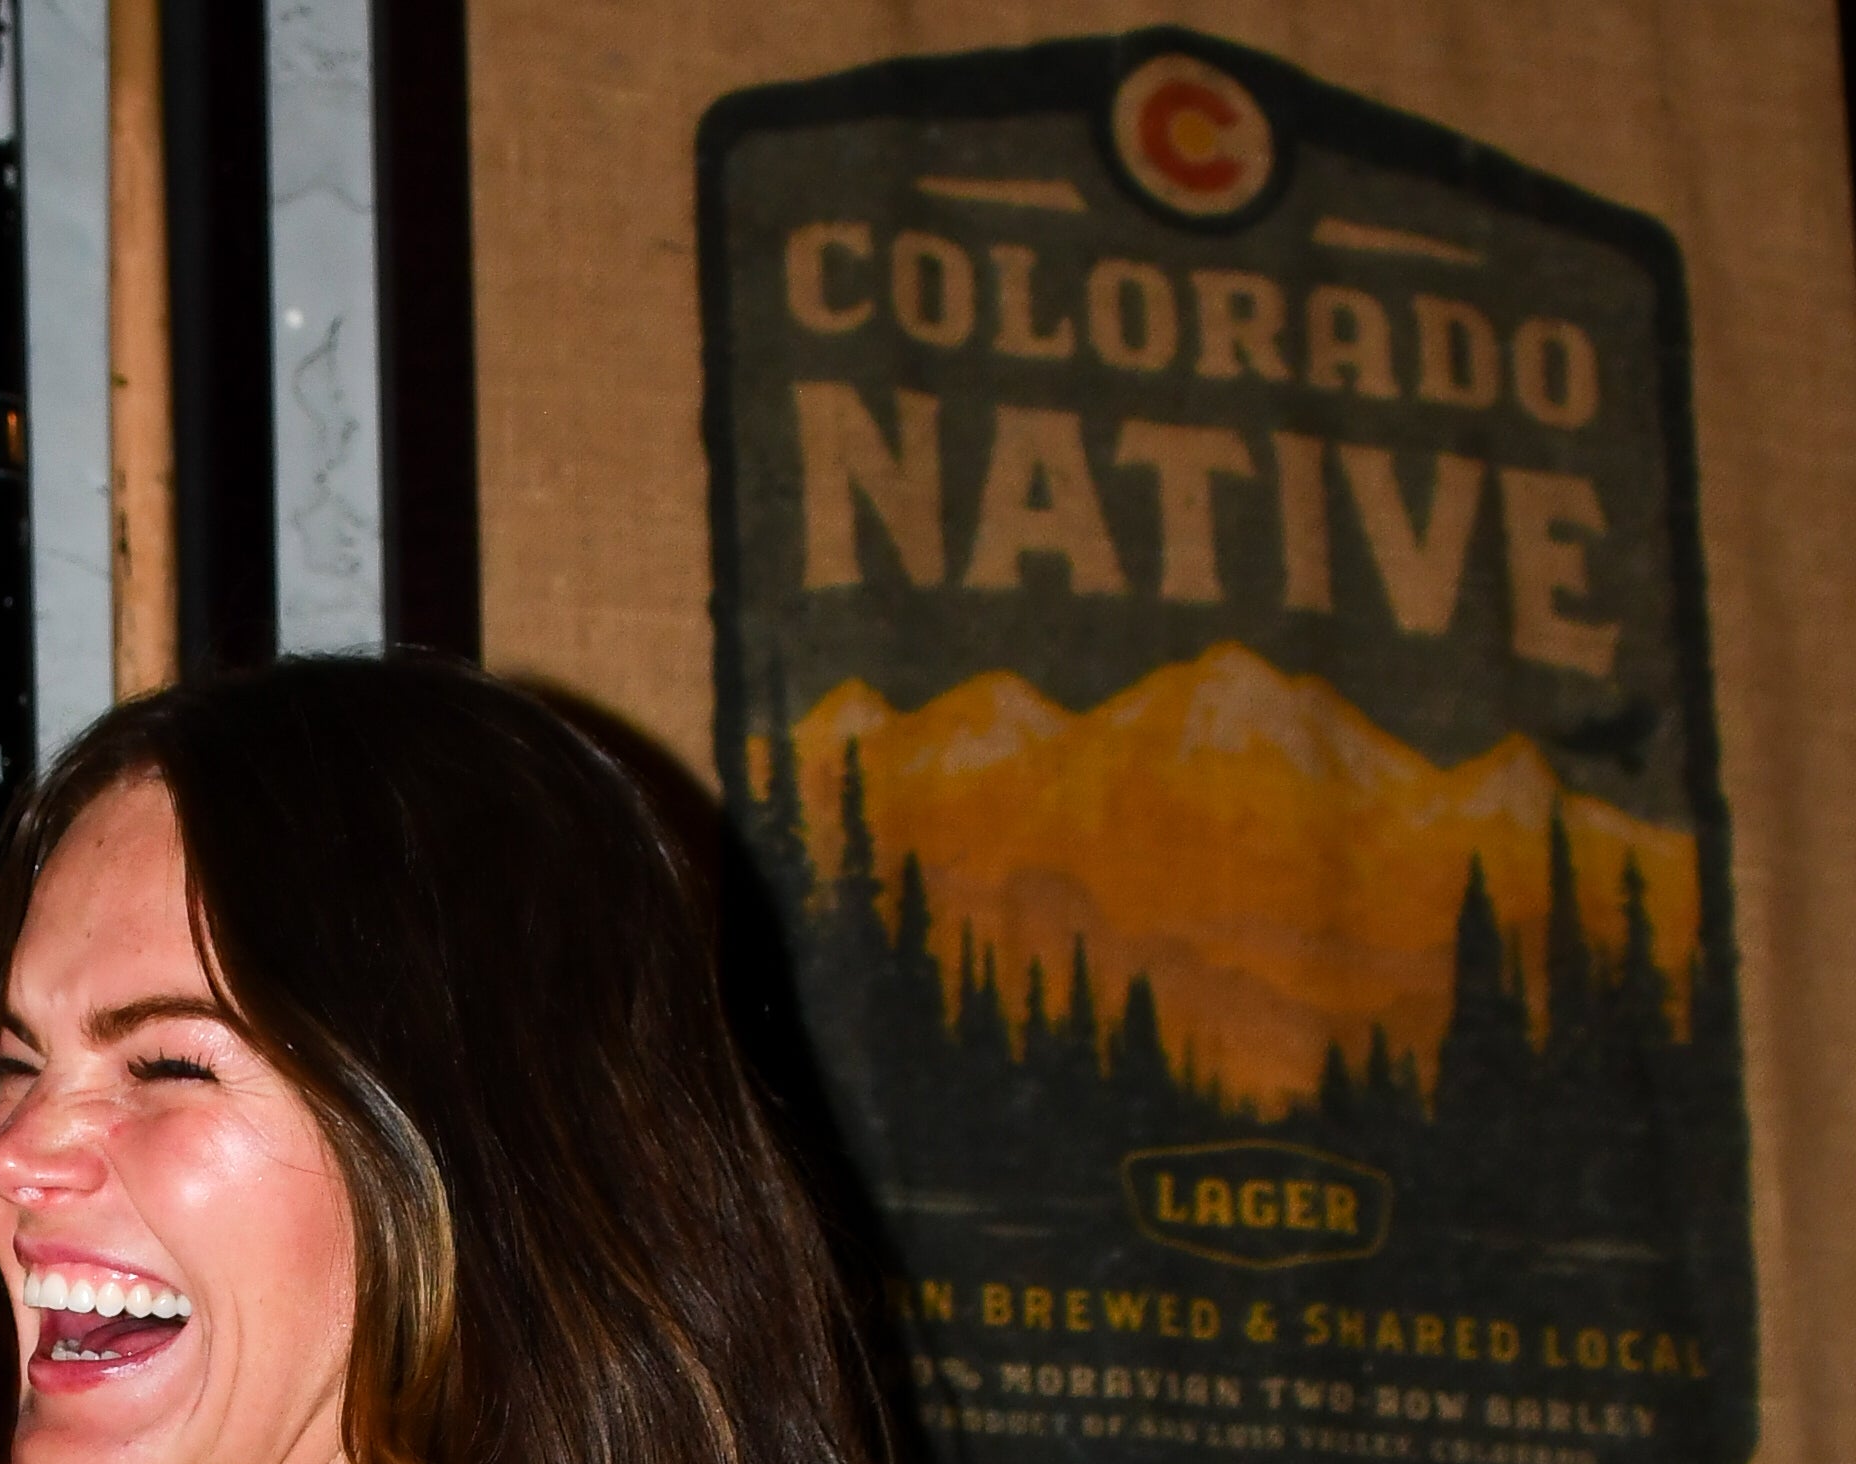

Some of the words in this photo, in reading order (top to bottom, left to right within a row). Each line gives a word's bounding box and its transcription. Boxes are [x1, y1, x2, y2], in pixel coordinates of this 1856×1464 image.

[784, 220, 1600, 432] COLORADO
[791, 380, 1622, 679] NATIVE
[1155, 1172, 1360, 1236] LAGER
[982, 1281, 1221, 1341] BREWED
[1245, 1299, 1278, 1343] &
[1302, 1301, 1523, 1364] SHARED
[1542, 1324, 1711, 1378] LOCAL
[1000, 1361, 1243, 1408] MORAVIAN
[1484, 1394, 1657, 1438] BARLEY
